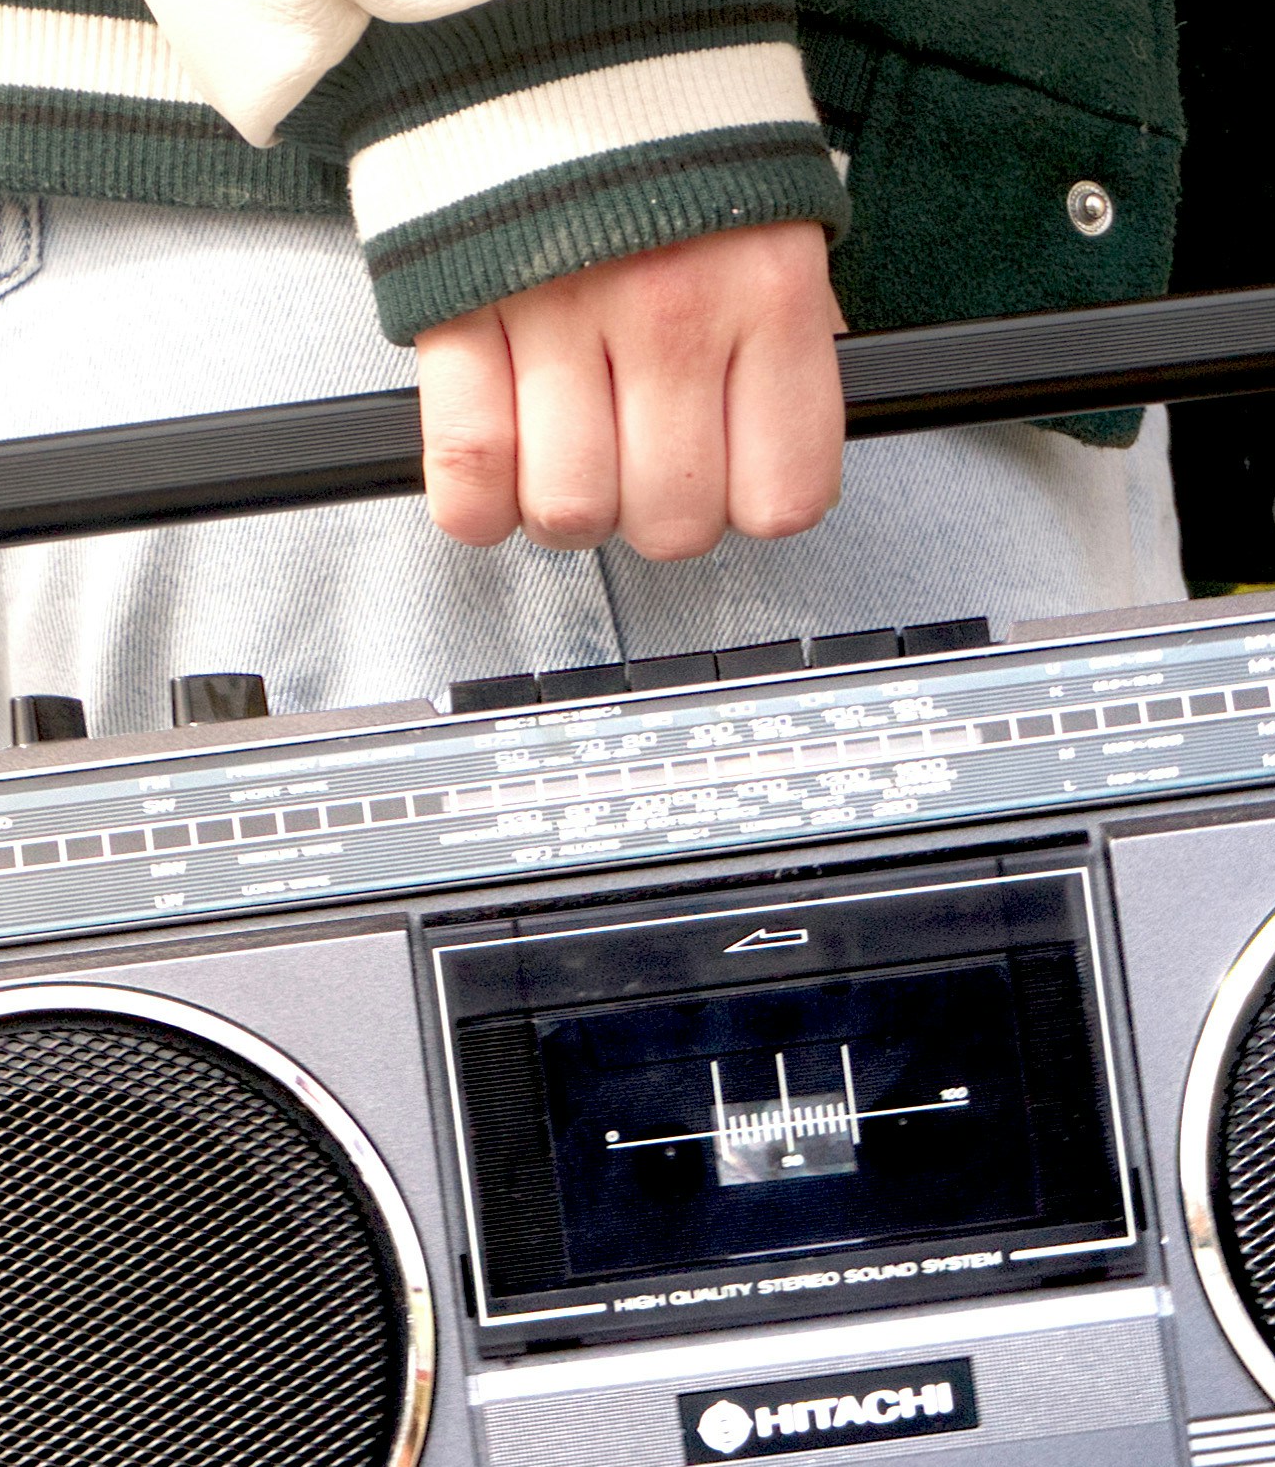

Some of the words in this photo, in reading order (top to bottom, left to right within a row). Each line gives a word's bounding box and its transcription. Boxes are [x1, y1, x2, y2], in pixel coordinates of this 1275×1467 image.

[938, 1086, 969, 1101] 100
[604, 1129, 620, 1143] 0
[613, 1292, 667, 1312] HIGH
[668, 1281, 753, 1305] QUALITY
[755, 1270, 840, 1294] STEREO
[842, 1260, 918, 1283] SOUND
[919, 1249, 1003, 1274] SYSTEM
[755, 1382, 954, 1438] HITACHI
